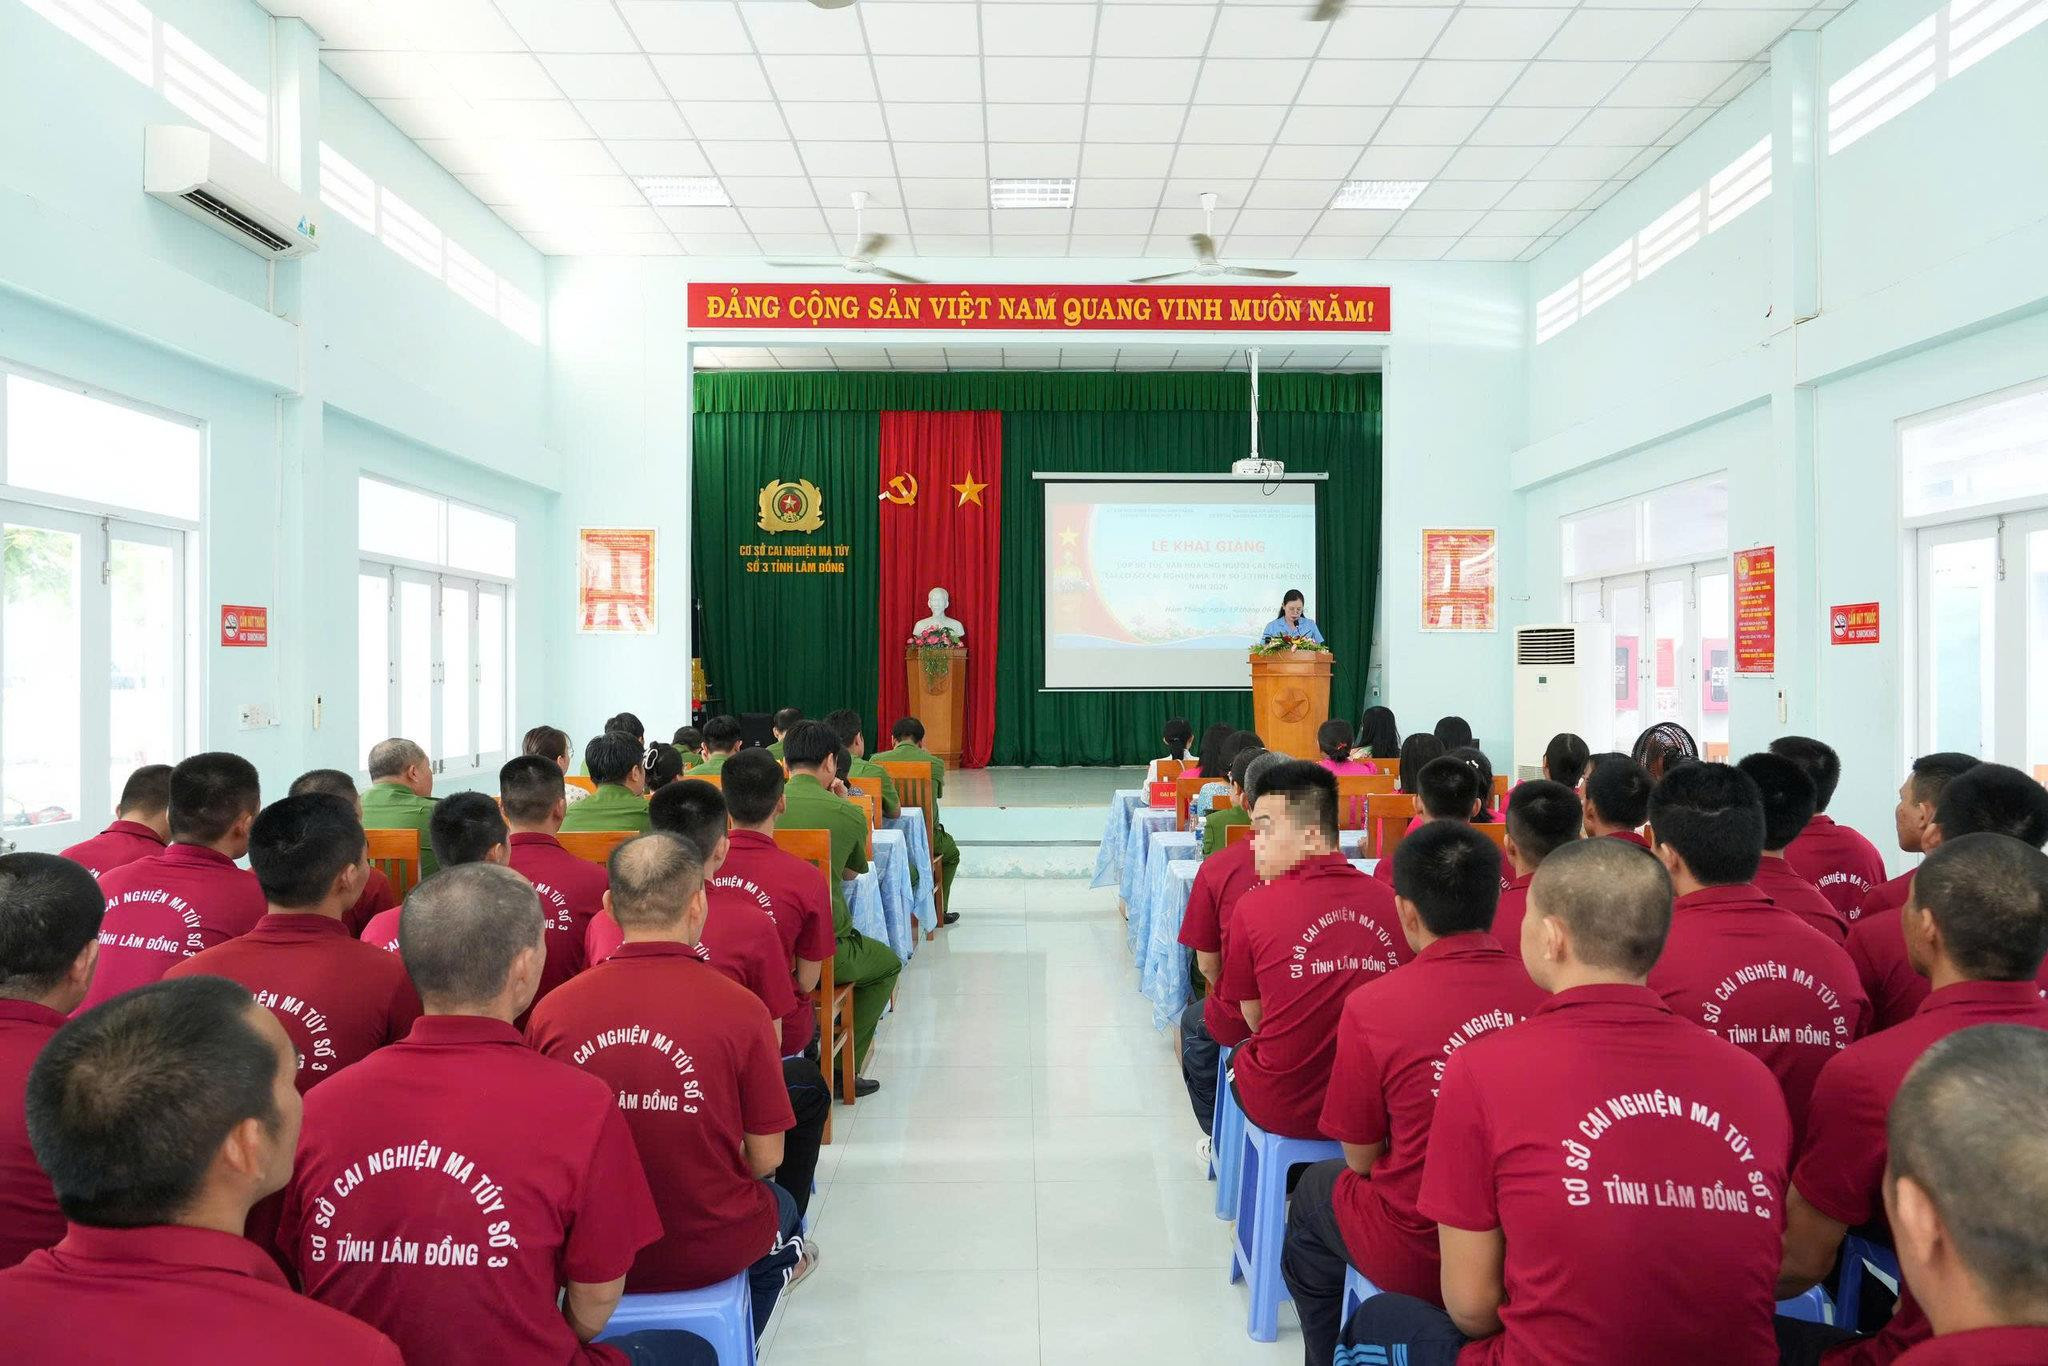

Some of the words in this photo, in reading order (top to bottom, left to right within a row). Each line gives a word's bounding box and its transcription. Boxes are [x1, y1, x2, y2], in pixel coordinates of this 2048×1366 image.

[706, 287, 781, 319] ĐẢNG
[788, 289, 860, 326] CỘNG
[867, 287, 921, 320] SẢN
[929, 290, 992, 326] VIỆT
[998, 296, 1057, 321] NAM
[1062, 296, 1152, 327] QUANG
[1157, 297, 1223, 322] VINH
[1229, 292, 1302, 322] MUÔN
[1307, 293, 1375, 323] NĂM!
[740, 545, 752, 556] CƠ
[753, 542, 766, 556] SỞ
[768, 545, 782, 556] CAI
[784, 544, 817, 559] NGHIỆN
[818, 545, 832, 556] MA
[834, 543, 849, 556] TÚY
[746, 558, 760, 572] SỐ
[762, 562, 769, 572] 3
[771, 559, 793, 573] TỈNH
[796, 560, 816, 573] LÂM
[818, 559, 845, 573] ĐỒNG
[1818, 871, 1847, 888] NGHIỆN
[1850, 873, 1862, 887] MA
[123, 889, 169, 904] NGHIỆN
[168, 896, 188, 912] MA
[535, 882, 551, 896] MA
[549, 890, 566, 907] TÚY
[558, 909, 573, 923] SỐ
[744, 881, 759, 895] MA
[756, 890, 772, 908] TÚY
[182, 908, 202, 928] TÚY
[1318, 907, 1356, 929] NGHIỆN
[1358, 914, 1376, 931] MA
[118, 933, 145, 949] LÂM
[145, 935, 179, 954] ĐỒNG
[186, 932, 205, 949] SỐ
[1302, 924, 1320, 943] CAI
[1376, 926, 1392, 948] TÚY
[182, 949, 197, 958] 3
[1292, 945, 1307, 961] SỞ
[1310, 958, 1334, 975] TỈNH
[1337, 955, 1359, 971] LÂM
[1361, 954, 1386, 973] ĐỒNG
[1289, 964, 1304, 980] CƠ
[1735, 960, 1787, 985] NGHIỆN
[1792, 968, 1814, 990] MA
[1715, 977, 1738, 1001] CAI
[1816, 982, 1841, 1011] TÚY
[280, 995, 305, 1016] MA
[1702, 1001, 1722, 1024] SỞ
[301, 1007, 328, 1035] TÚY
[1461, 1008, 1514, 1039] NGHIỆN
[1833, 1016, 1849, 1037] SỐ
[596, 1024, 650, 1049] NGHIỆN
[651, 1032, 674, 1055] MA
[1727, 1024, 1758, 1044] TỈNH
[1762, 1024, 1790, 1043] LÂM
[1795, 1023, 1831, 1046] ĐỒNG
[1836, 1041, 1847, 1050] 3
[313, 1038, 337, 1059] SỐ
[573, 1040, 596, 1065] CAI
[311, 1062, 328, 1072] 3
[671, 1048, 695, 1076] TÚY
[618, 1090, 638, 1110] ÂM
[642, 1088, 679, 1112] ĐỒNG
[683, 1080, 705, 1102] SỐ
[683, 1104, 698, 1114] 3
[1606, 1089, 1683, 1120] NGHIỆN
[1578, 1107, 1613, 1140] CAI
[1690, 1101, 1721, 1132] MA
[1724, 1123, 1755, 1163] TÚY
[367, 1139, 442, 1176] NGHIỆN
[1561, 1139, 1592, 1172] SỞ
[442, 1151, 475, 1185] MA
[333, 1163, 364, 1198] CAI
[1561, 1177, 1591, 1207] CƠ
[1748, 1170, 1774, 1201] SỐ
[470, 1174, 505, 1215] TÚY
[1603, 1174, 1649, 1206] TỈNH
[1654, 1179, 1696, 1209] LÂM
[1701, 1180, 1749, 1213] ĐỒNG
[315, 1196, 336, 1229] SỞ
[1755, 1205, 1771, 1220] 3
[487, 1220, 519, 1250] SỐ
[311, 1234, 327, 1262] CƠ
[336, 1232, 375, 1262] TỈNH
[381, 1236, 419, 1265] LÂM
[424, 1235, 478, 1267] ĐỒNG
[487, 1256, 509, 1268] 3
